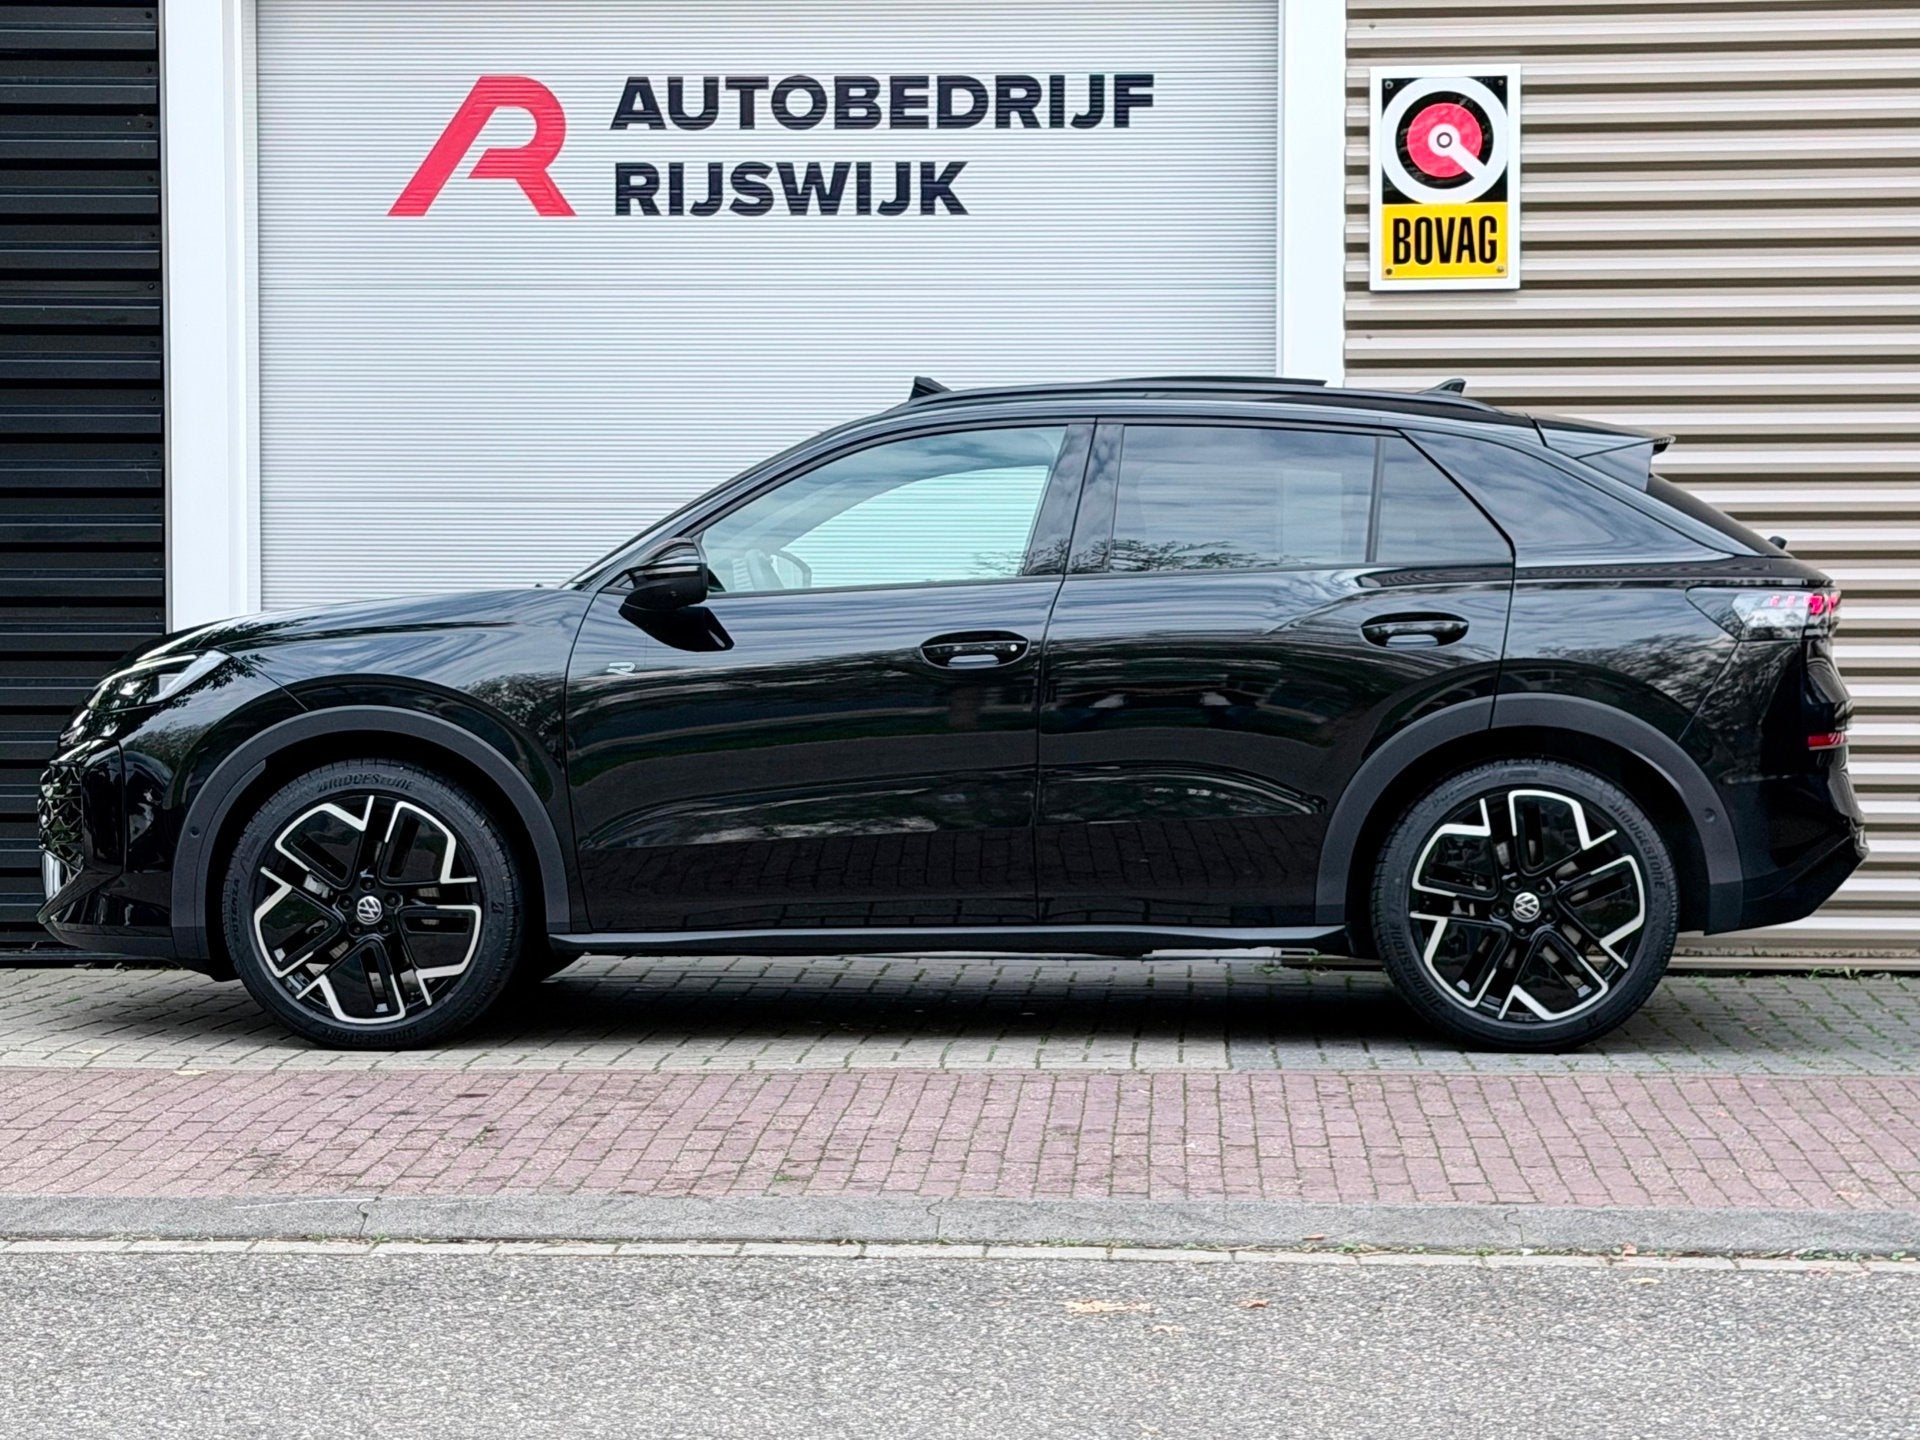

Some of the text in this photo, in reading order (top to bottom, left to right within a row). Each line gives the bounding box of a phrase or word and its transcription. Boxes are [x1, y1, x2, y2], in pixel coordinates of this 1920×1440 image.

[611, 75, 1153, 130] AUTOBEDRIJF
[616, 162, 966, 216] RIJSWIJK
[1393, 215, 1497, 265] BOVAG
[1609, 804, 1666, 889] BRIDGESTONE
